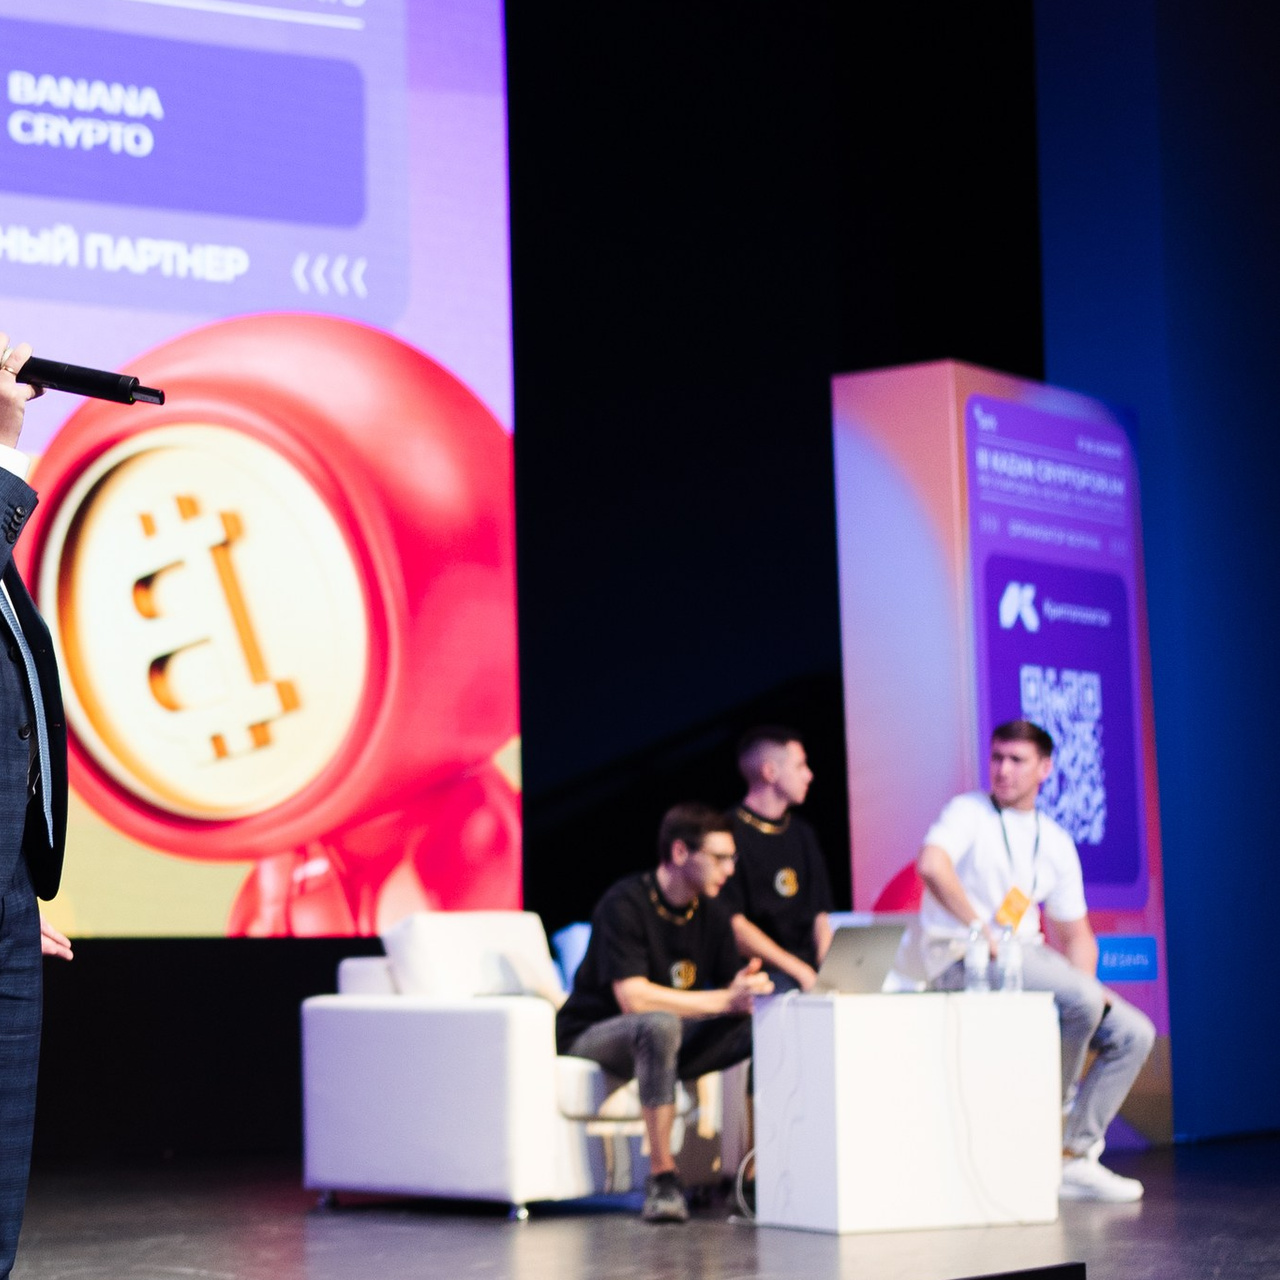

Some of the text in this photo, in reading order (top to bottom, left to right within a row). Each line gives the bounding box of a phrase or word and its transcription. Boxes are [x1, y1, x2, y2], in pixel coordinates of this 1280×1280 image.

[7, 70, 164, 120] BANANA
[7, 110, 154, 157] CRYPTO
[84, 232, 250, 282] ПАРТНЕР
